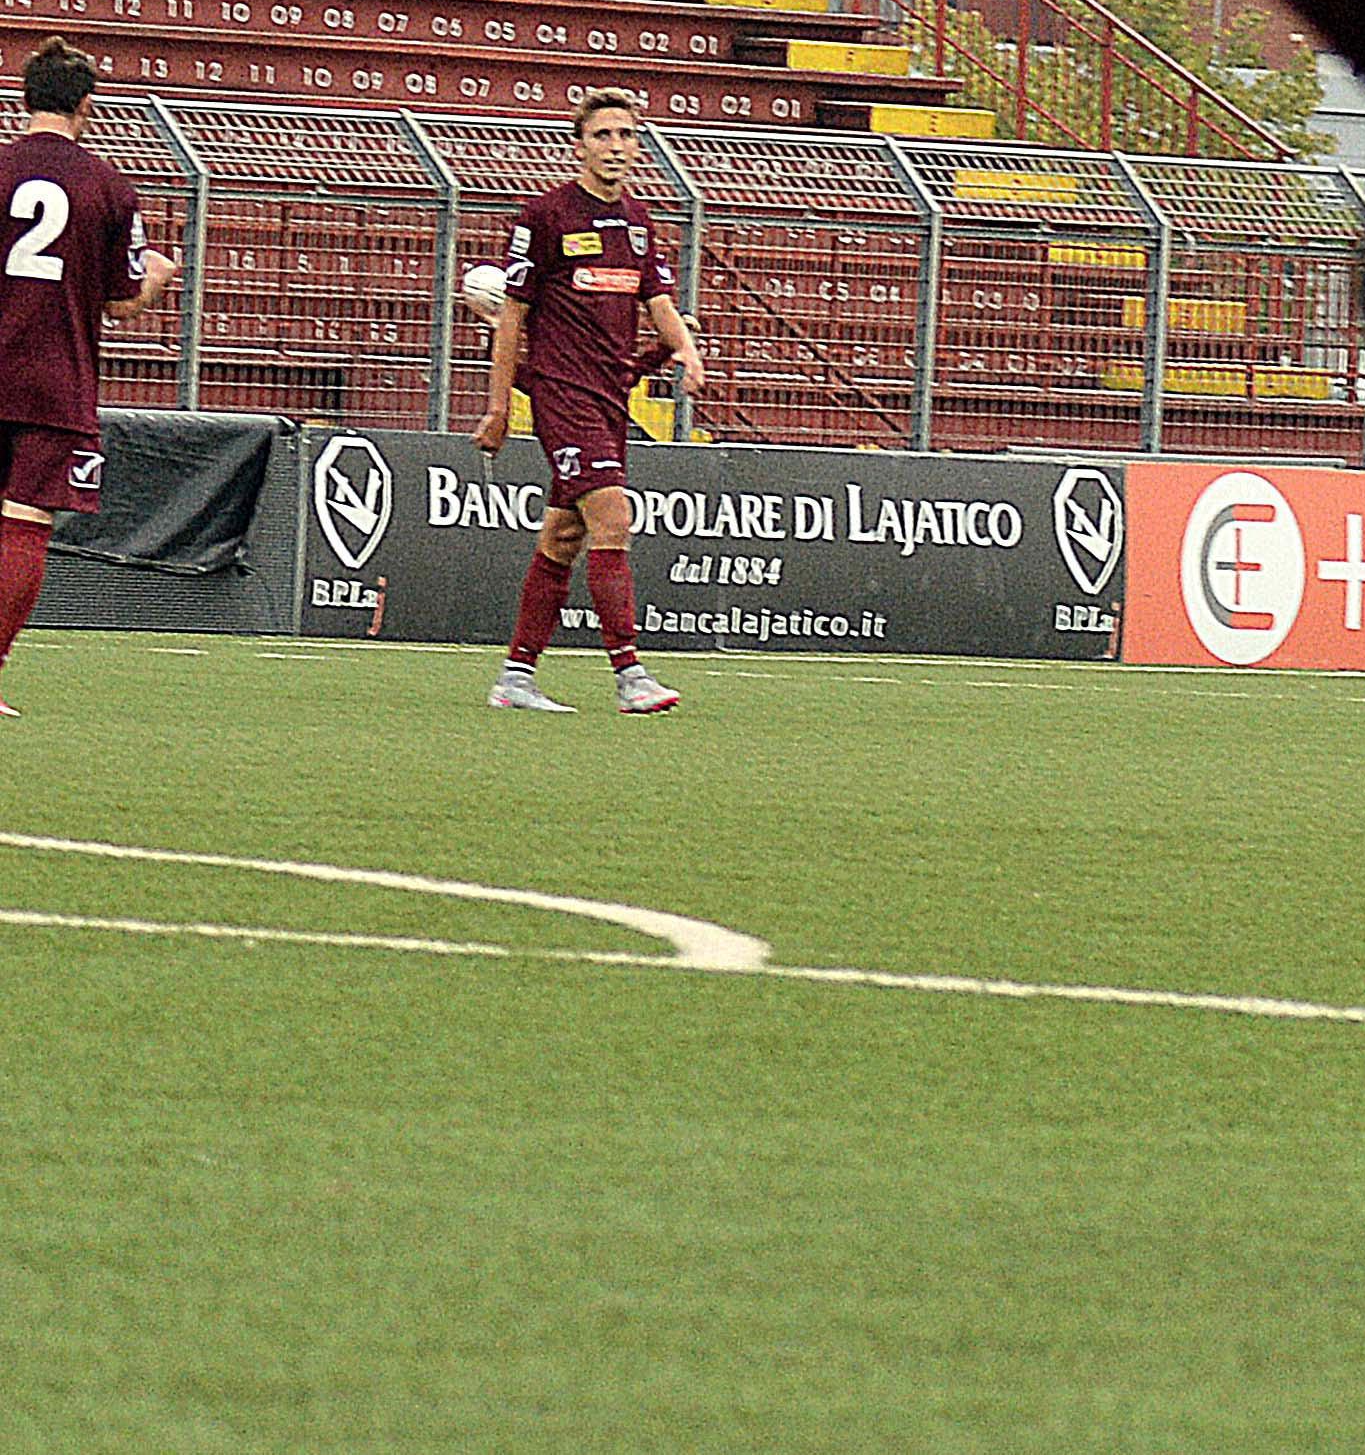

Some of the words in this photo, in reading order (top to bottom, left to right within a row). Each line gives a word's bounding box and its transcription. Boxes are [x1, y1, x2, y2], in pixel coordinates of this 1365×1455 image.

[221, 1, 250, 23] 10
[270, 5, 302, 25] 09
[377, 12, 409, 33] 07
[484, 20, 516, 41] 05
[587, 30, 618, 51] 03
[639, 31, 670, 52] 02
[689, 35, 718, 56] 01
[140, 57, 168, 78] 13
[195, 60, 223, 82] 12
[249, 64, 275, 85] 11
[302, 67, 333, 88] 10
[352, 70, 384, 91] 09
[459, 77, 491, 98] 07
[669, 94, 700, 115] 03
[721, 95, 752, 116] 02
[771, 98, 801, 119] 01
[5, 179, 69, 281] 2
[429, 466, 544, 531] BANC
[623, 488, 786, 539] OPOLARE
[794, 496, 835, 541] DI
[845, 483, 1022, 556] LAJATICO
[670, 554, 713, 583] dal
[717, 556, 782, 585] 1884
[560, 604, 887, 642] ww.bancalajatico.it
